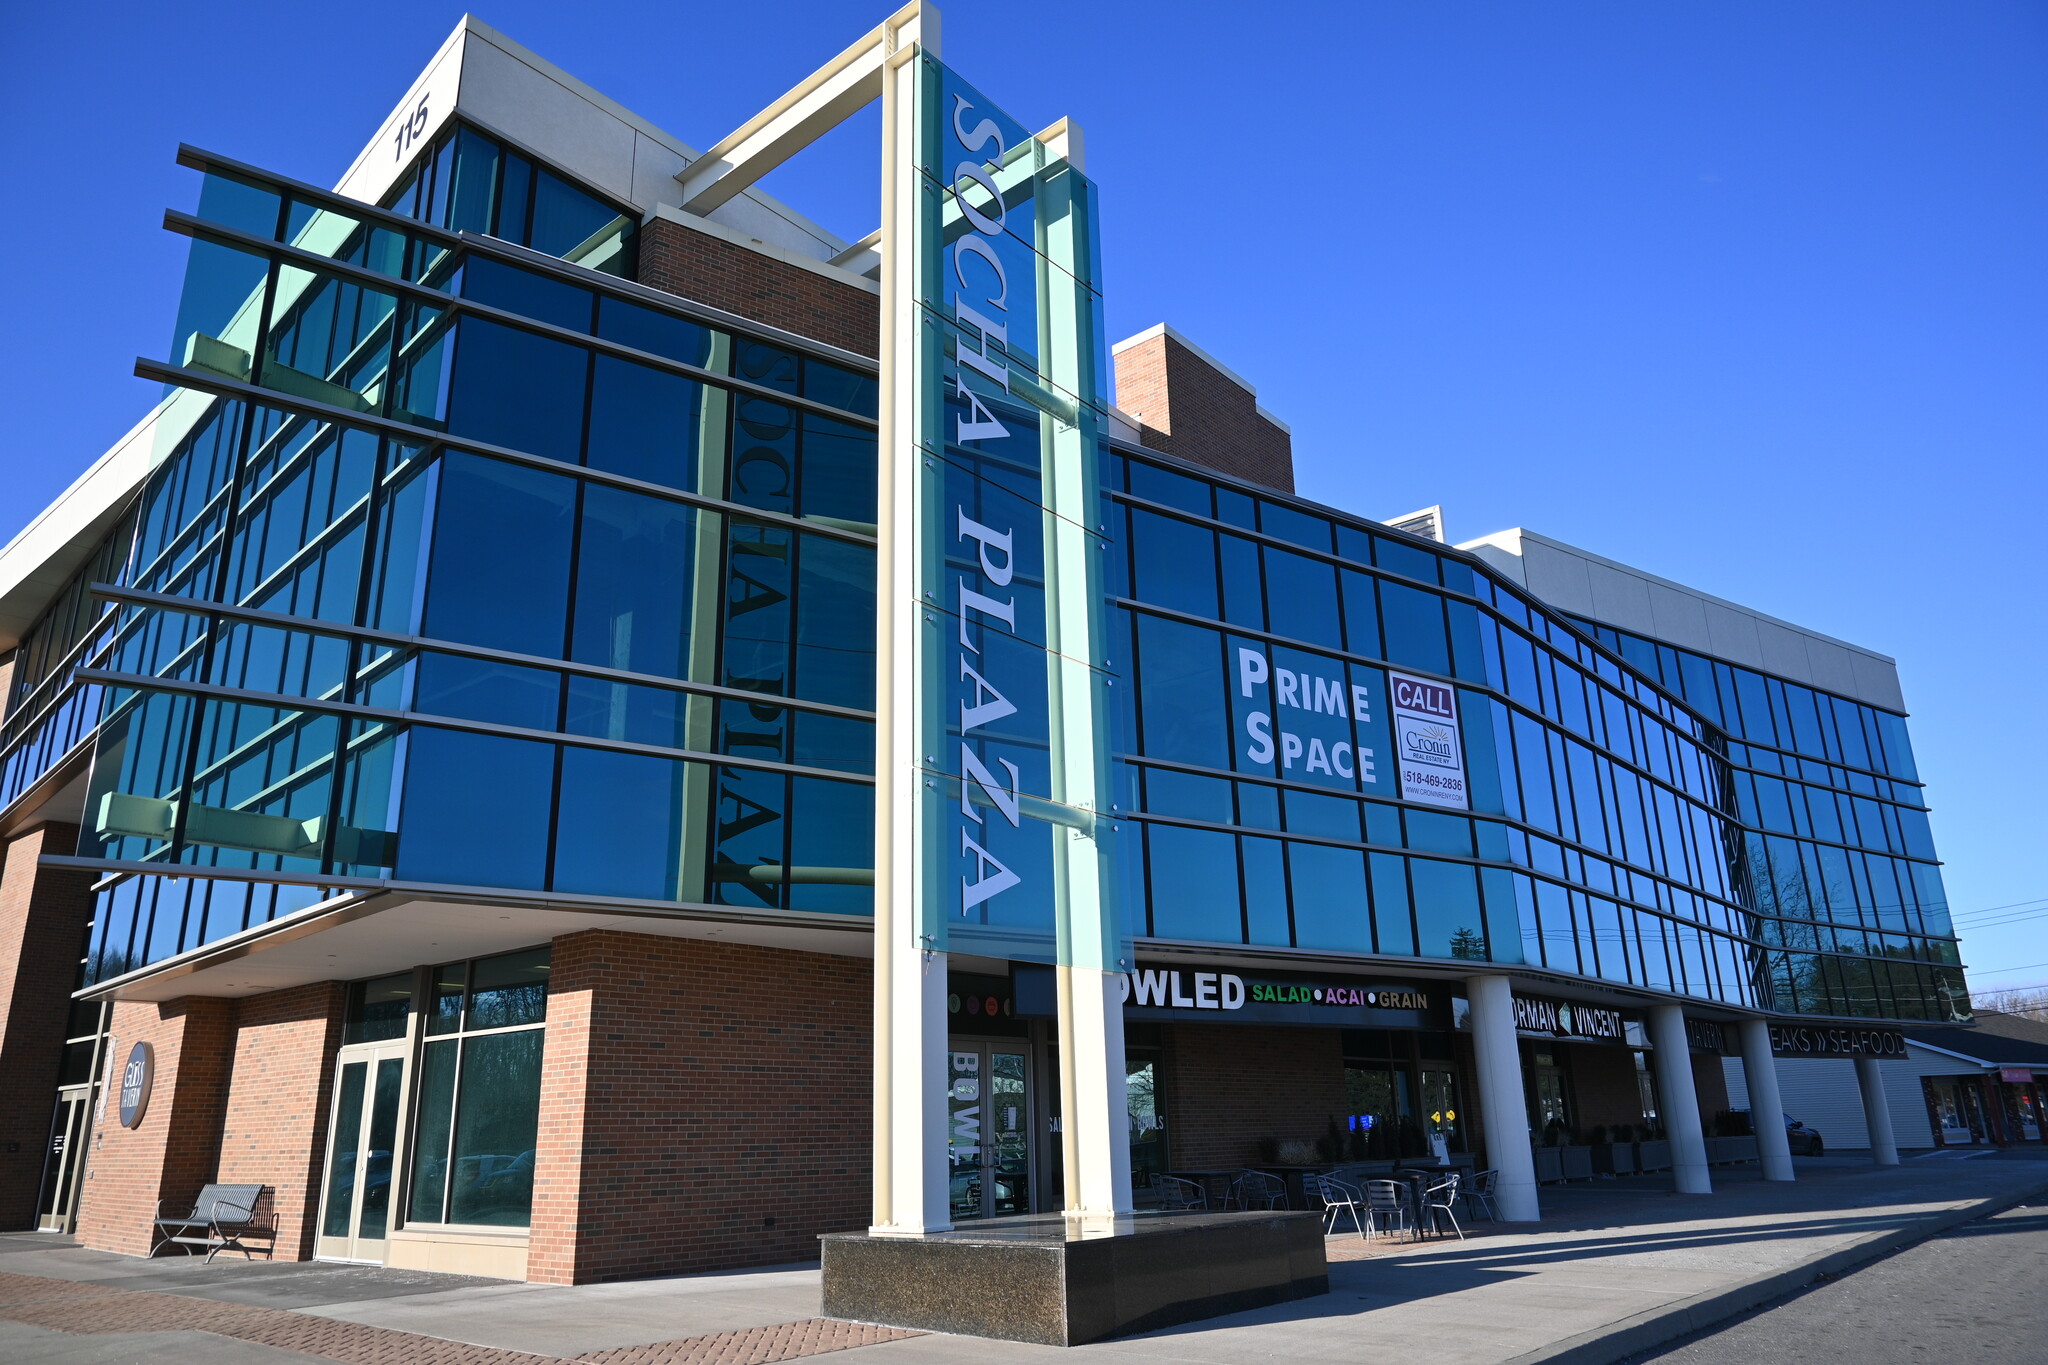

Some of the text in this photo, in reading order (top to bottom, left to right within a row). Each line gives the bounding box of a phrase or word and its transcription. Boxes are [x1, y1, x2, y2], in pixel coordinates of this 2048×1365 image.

[394, 91, 430, 163] 115
[953, 93, 1021, 917] SOCHA PLAZA
[1238, 647, 1371, 723] PRIME
[1397, 682, 1450, 715] CALL
[1246, 711, 1377, 783] SPACE
[1406, 730, 1452, 756] Cronin
[1412, 753, 1425, 761] REAL
[1426, 755, 1442, 764] ESTATE
[1404, 786, 1463, 802] WWW.CRONINRENY.COM
[1406, 770, 1463, 791] 518-469-2836
[1252, 984, 1312, 1004] SALAD
[1325, 988, 1365, 1006] ACAI
[1378, 991, 1428, 1009] GRAIN
[1573, 1005, 1621, 1038] VINCENT
[1688, 1020, 1724, 1049] TAVERN
[1829, 1029, 1906, 1055] SEAFOOD
[121, 1087, 142, 1108] TAVERN
